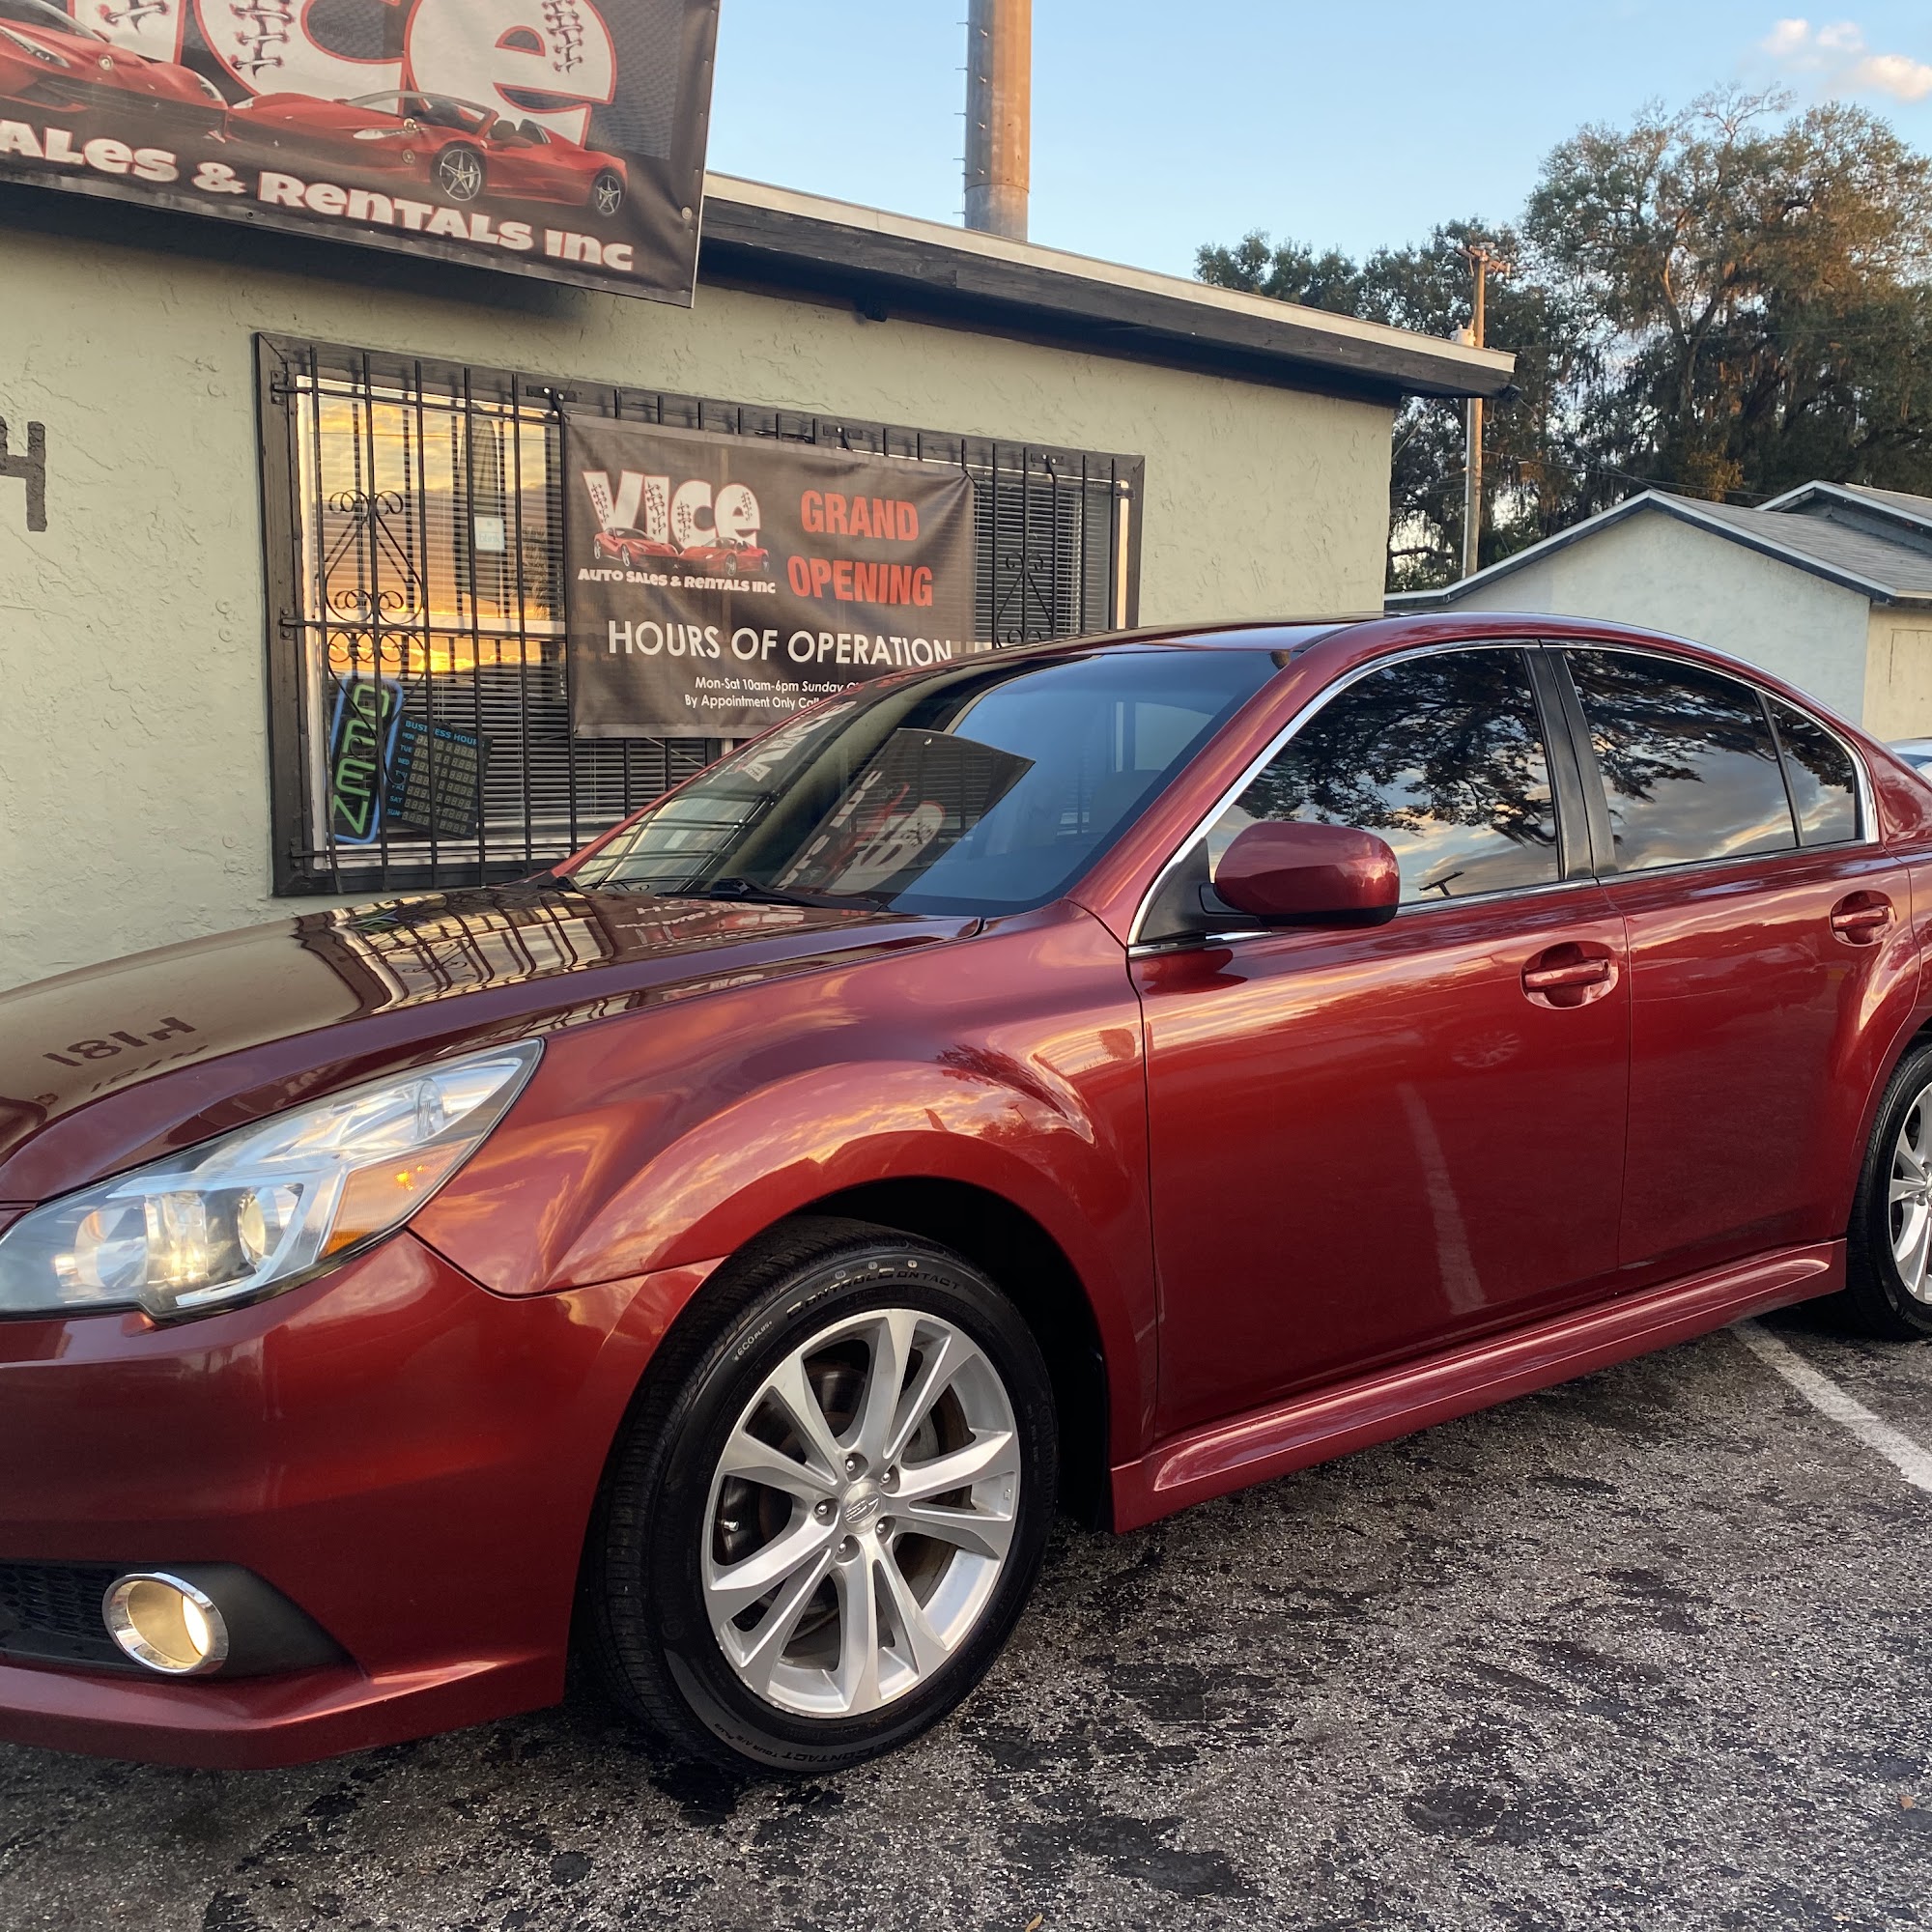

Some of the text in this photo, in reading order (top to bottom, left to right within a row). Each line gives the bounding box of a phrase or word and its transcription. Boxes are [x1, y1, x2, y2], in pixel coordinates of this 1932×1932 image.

[192, 161, 247, 195] &
[544, 227, 635, 272] Inc
[801, 490, 919, 541] GRAND
[578, 568, 624, 582] AUTO
[670, 575, 682, 587] &
[786, 555, 933, 607] OPENING
[609, 620, 952, 667] HOURS OF OPERATION
[696, 676, 740, 690] Mon-Sat
[742, 678, 799, 694] 10am-6pm
[801, 680, 844, 693] Sunday
[684, 695, 697, 708] By
[701, 695, 770, 709] Appointment
[772, 696, 795, 710] Only
[406, 720, 485, 748] BUSIESS HOU
[400, 745, 412, 753] TUE
[389, 795, 403, 804] SAT
